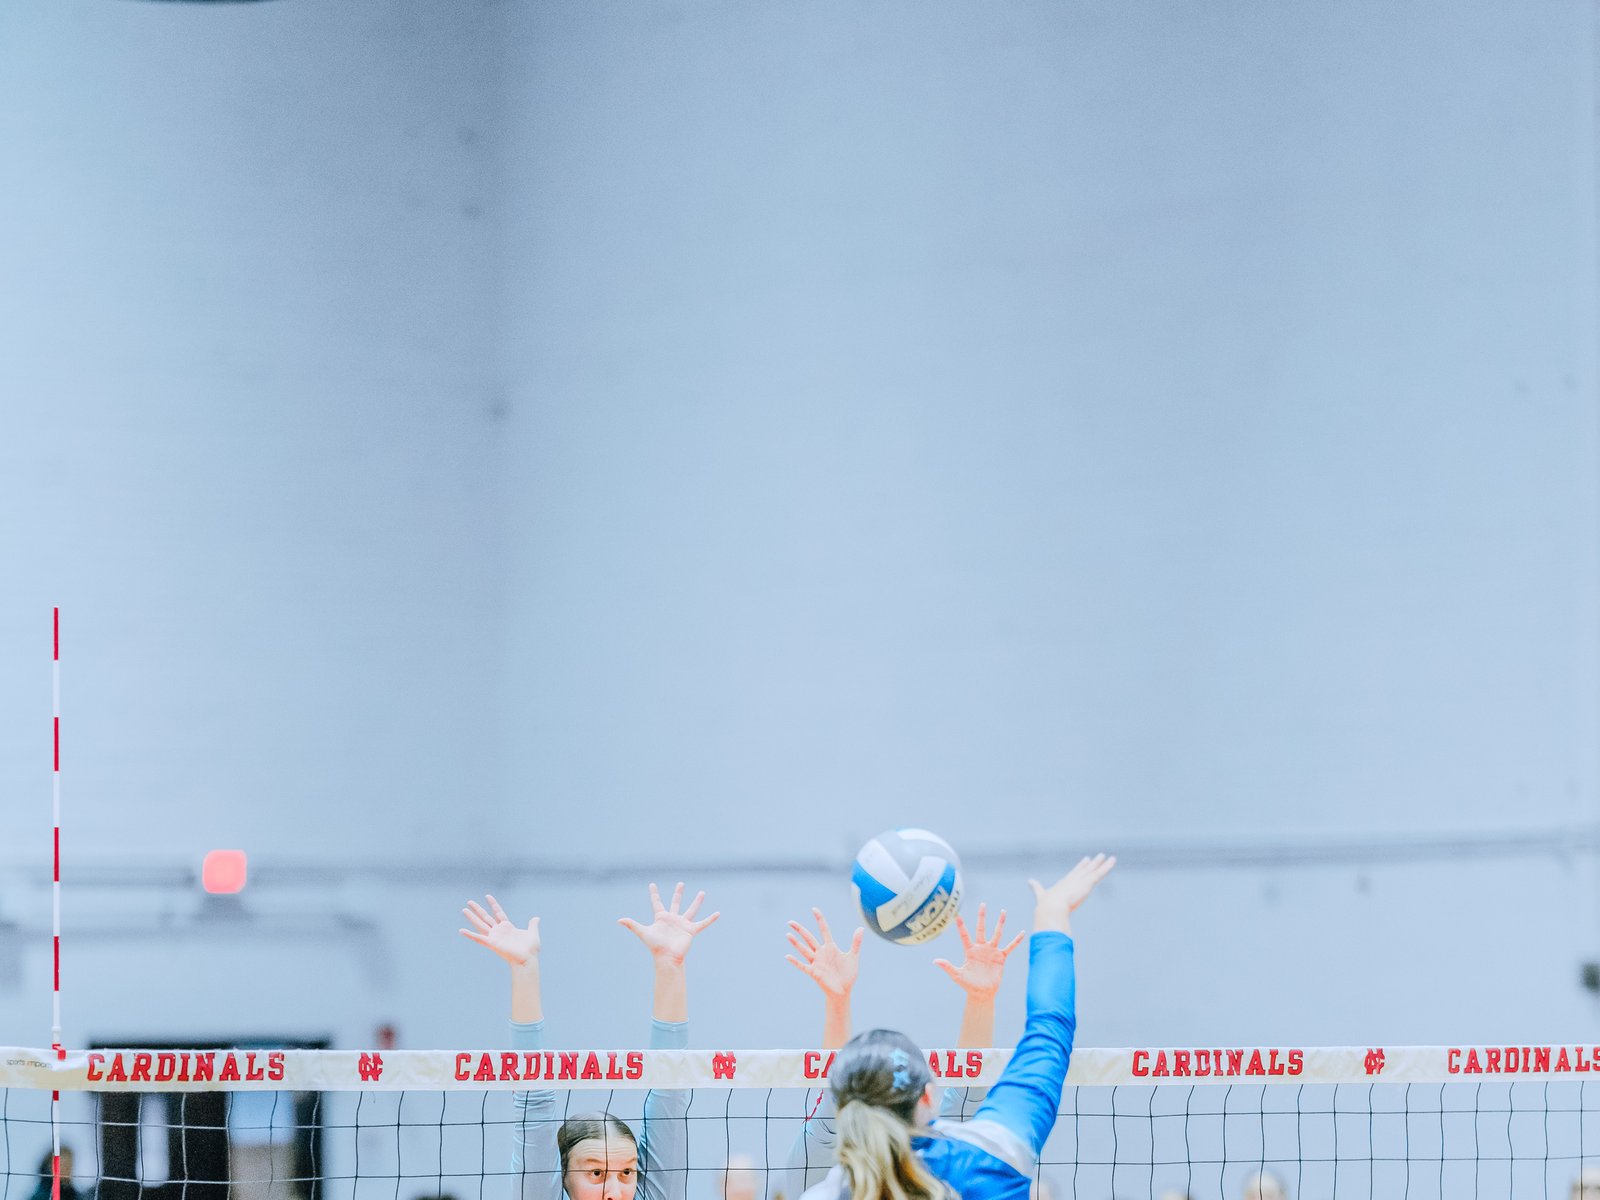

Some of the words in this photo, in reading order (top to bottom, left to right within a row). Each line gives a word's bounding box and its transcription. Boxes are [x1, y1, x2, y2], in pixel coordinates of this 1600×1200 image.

[86, 1052, 285, 1083] CARDINALS
[454, 1052, 644, 1081] CARDINALS
[1131, 1048, 1304, 1077] CARDINALS
[1447, 1046, 1600, 1074] CARDINALS
